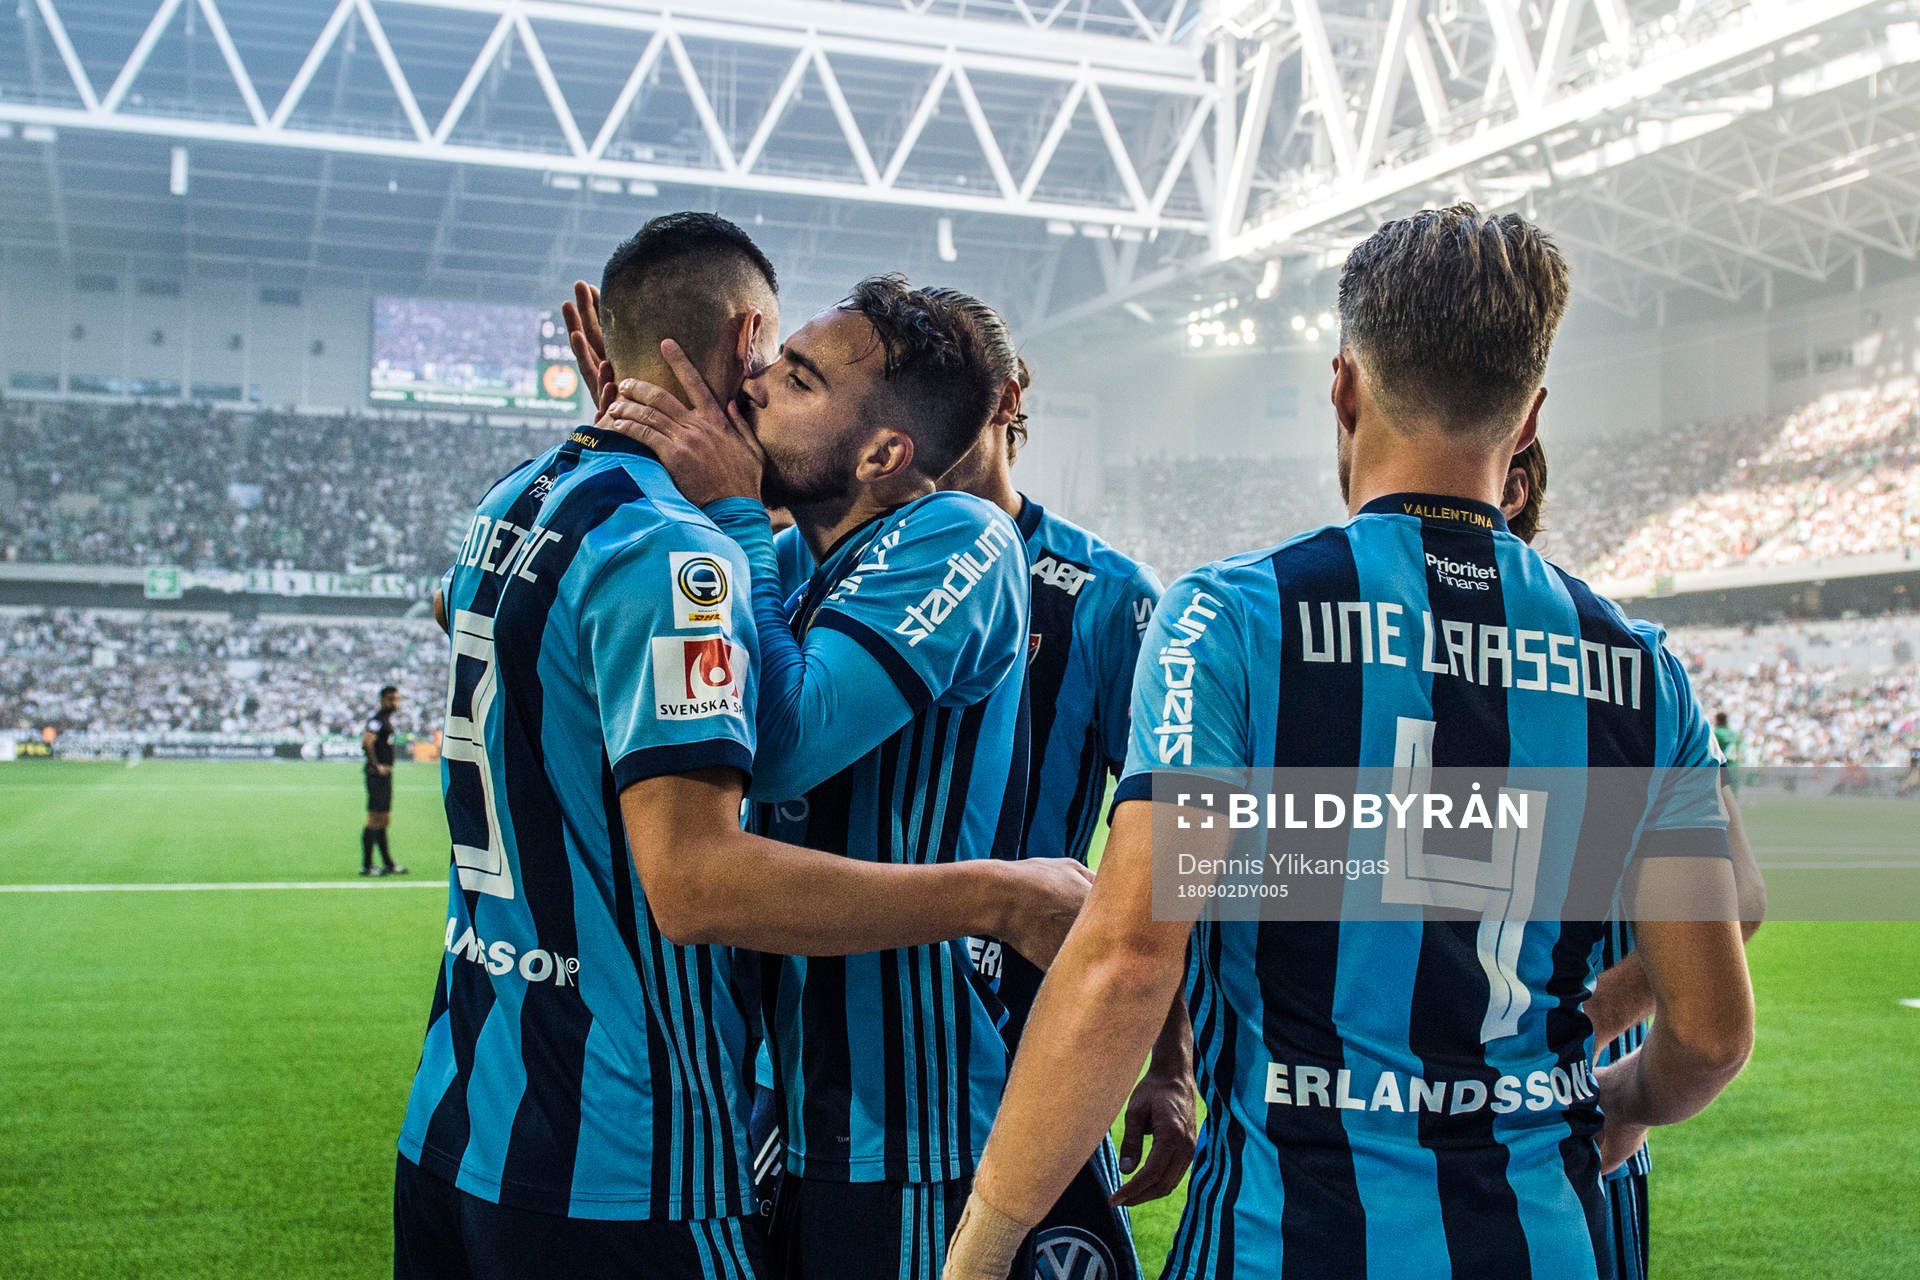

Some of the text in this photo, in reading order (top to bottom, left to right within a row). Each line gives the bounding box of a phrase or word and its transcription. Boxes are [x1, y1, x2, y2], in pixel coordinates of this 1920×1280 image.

[1403, 502, 1494, 529] VALLENTUNA
[894, 517, 1014, 648] stadium
[1031, 556, 1096, 596] ABT
[1425, 552, 1498, 579] Prioritet
[1436, 569, 1490, 591] Finans
[1153, 587, 1225, 766] stadium
[1299, 601, 1642, 710] UNE LARSSON
[660, 698, 729, 716] SVENSKA
[441, 608, 515, 900] 9
[1381, 716, 1549, 1044] 4
[1264, 1061, 1595, 1116] ERLANDSSON
